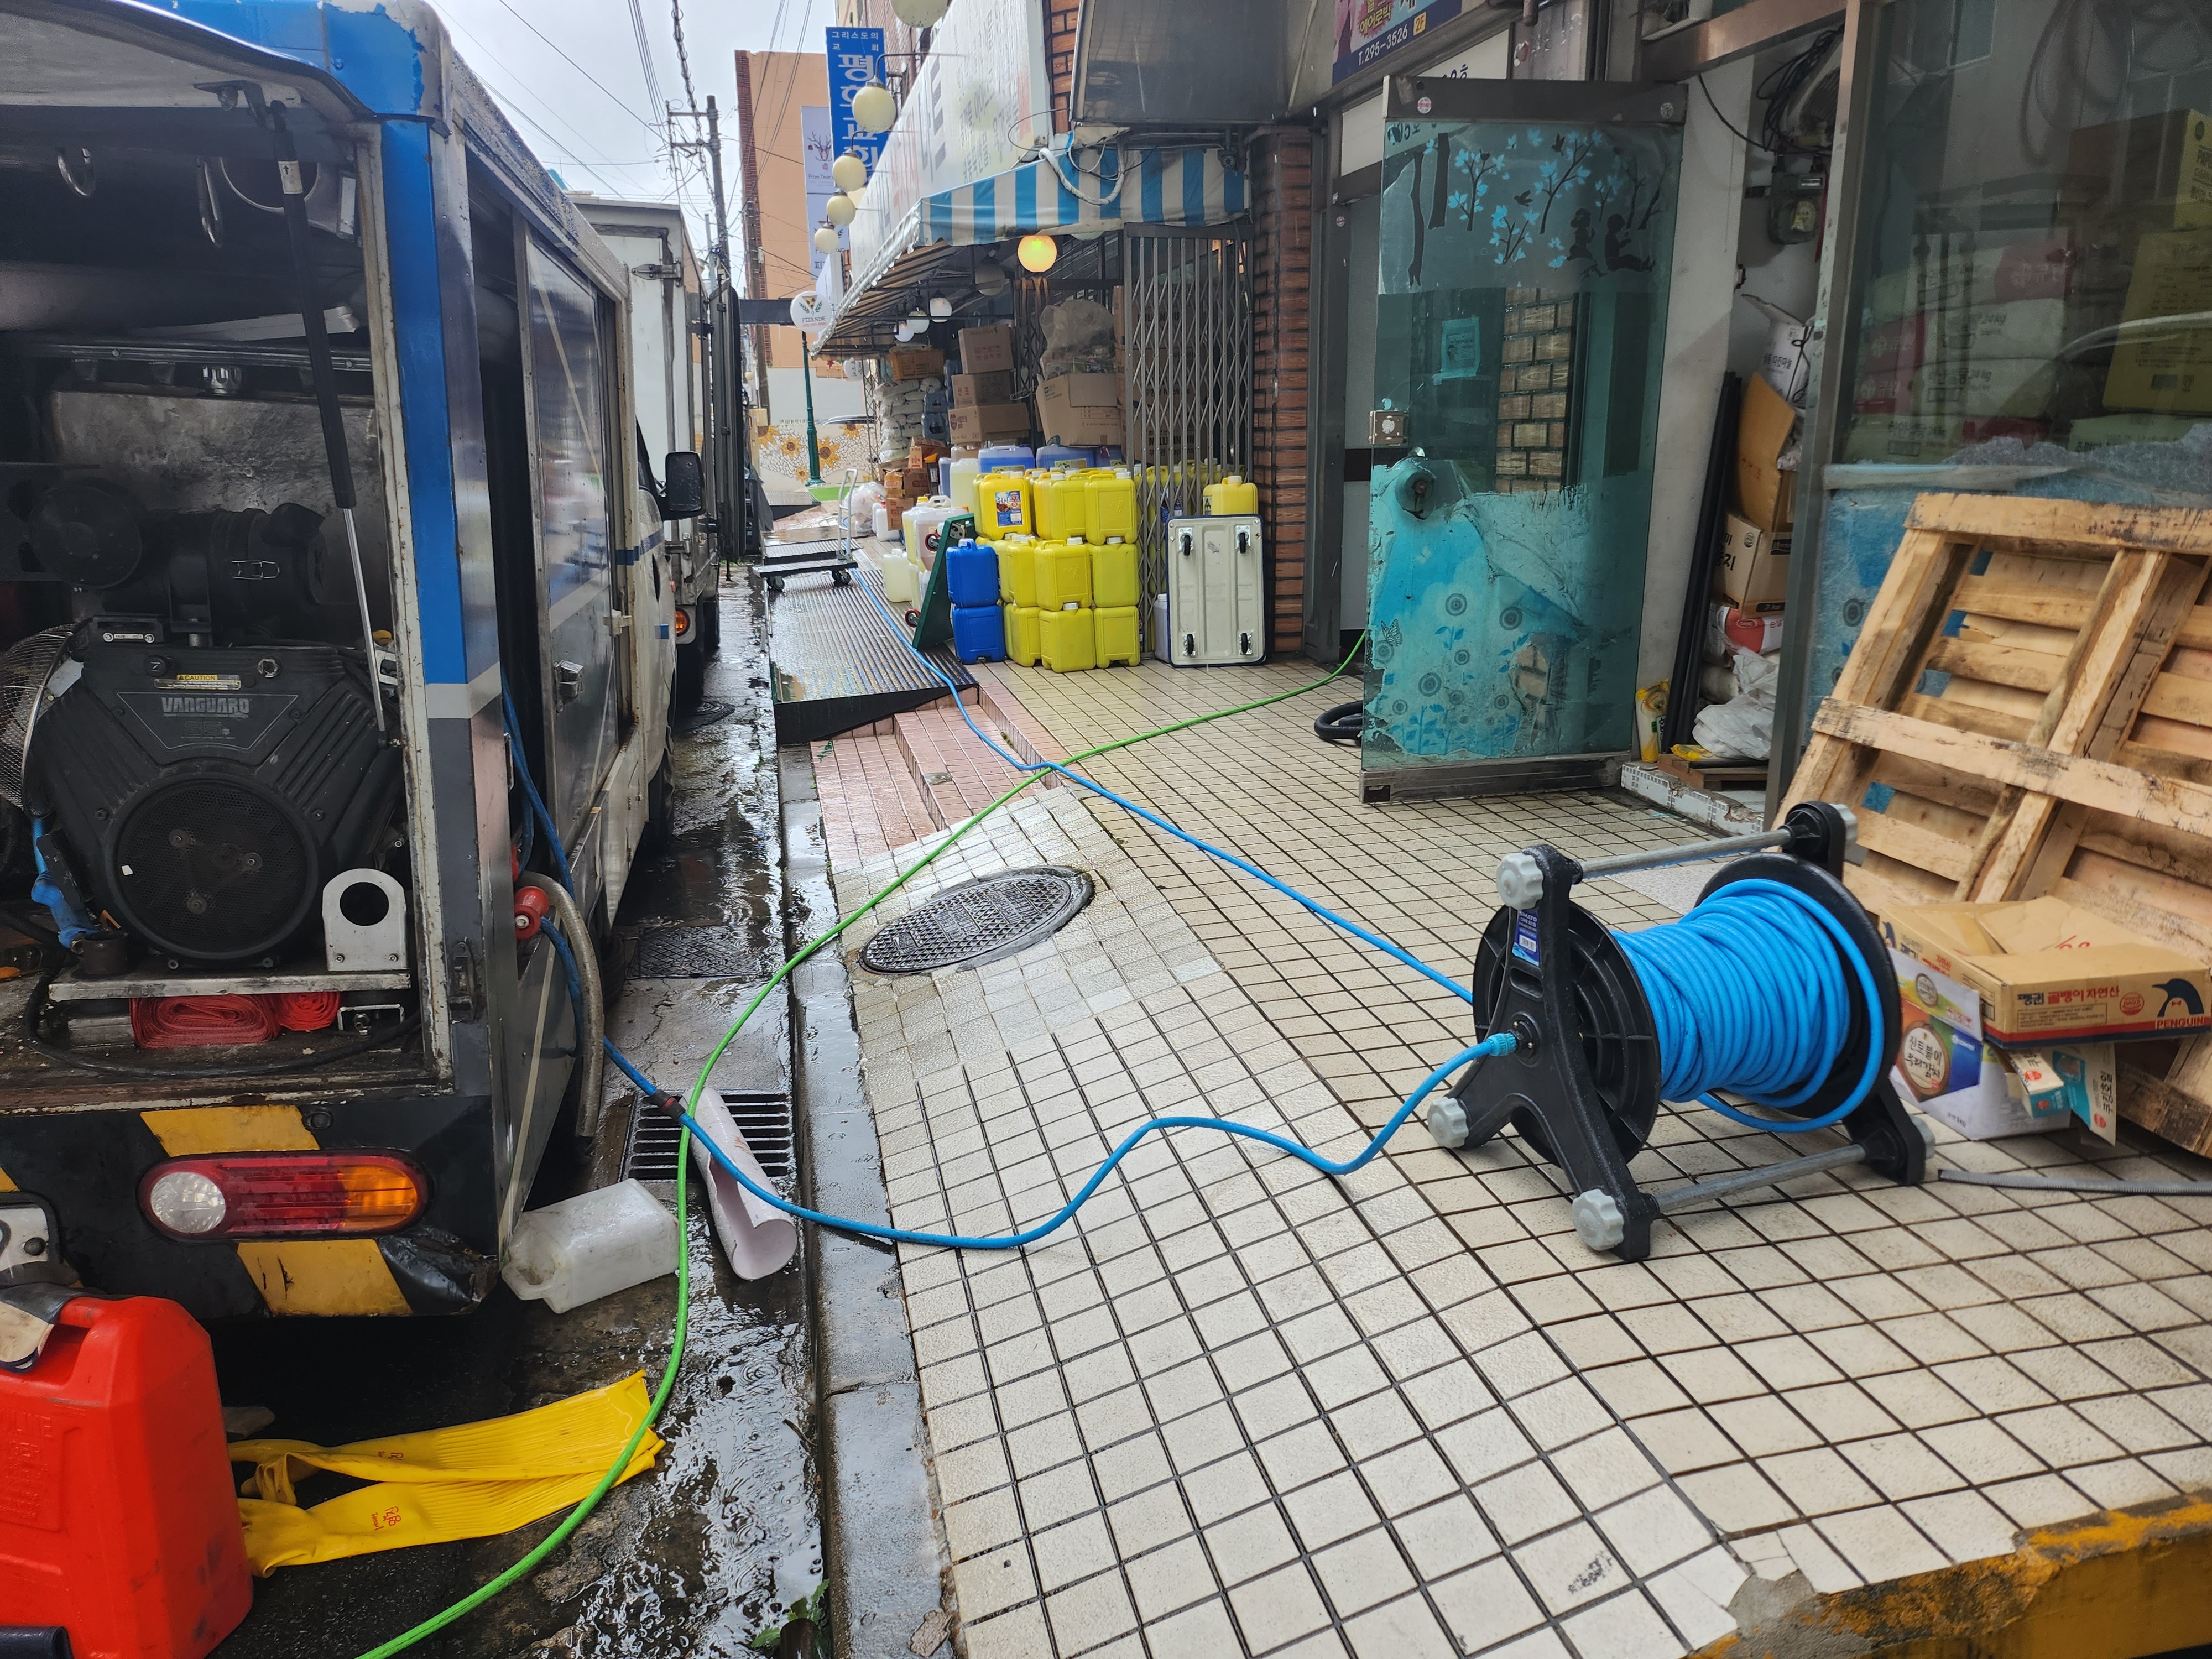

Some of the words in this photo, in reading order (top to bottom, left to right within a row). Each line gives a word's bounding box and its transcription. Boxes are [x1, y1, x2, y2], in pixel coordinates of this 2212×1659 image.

[1359, 3, 1392, 34] 에어로빅
[831, 32, 878, 40] 그리스도의
[1358, 24, 1408, 66] T.295-3526
[1416, 12, 1426, 32] 2F
[161, 697, 249, 713] VANGUARD
[2087, 985, 2120, 999] 자연산
[2157, 1016, 2204, 1030] PENGUIN
